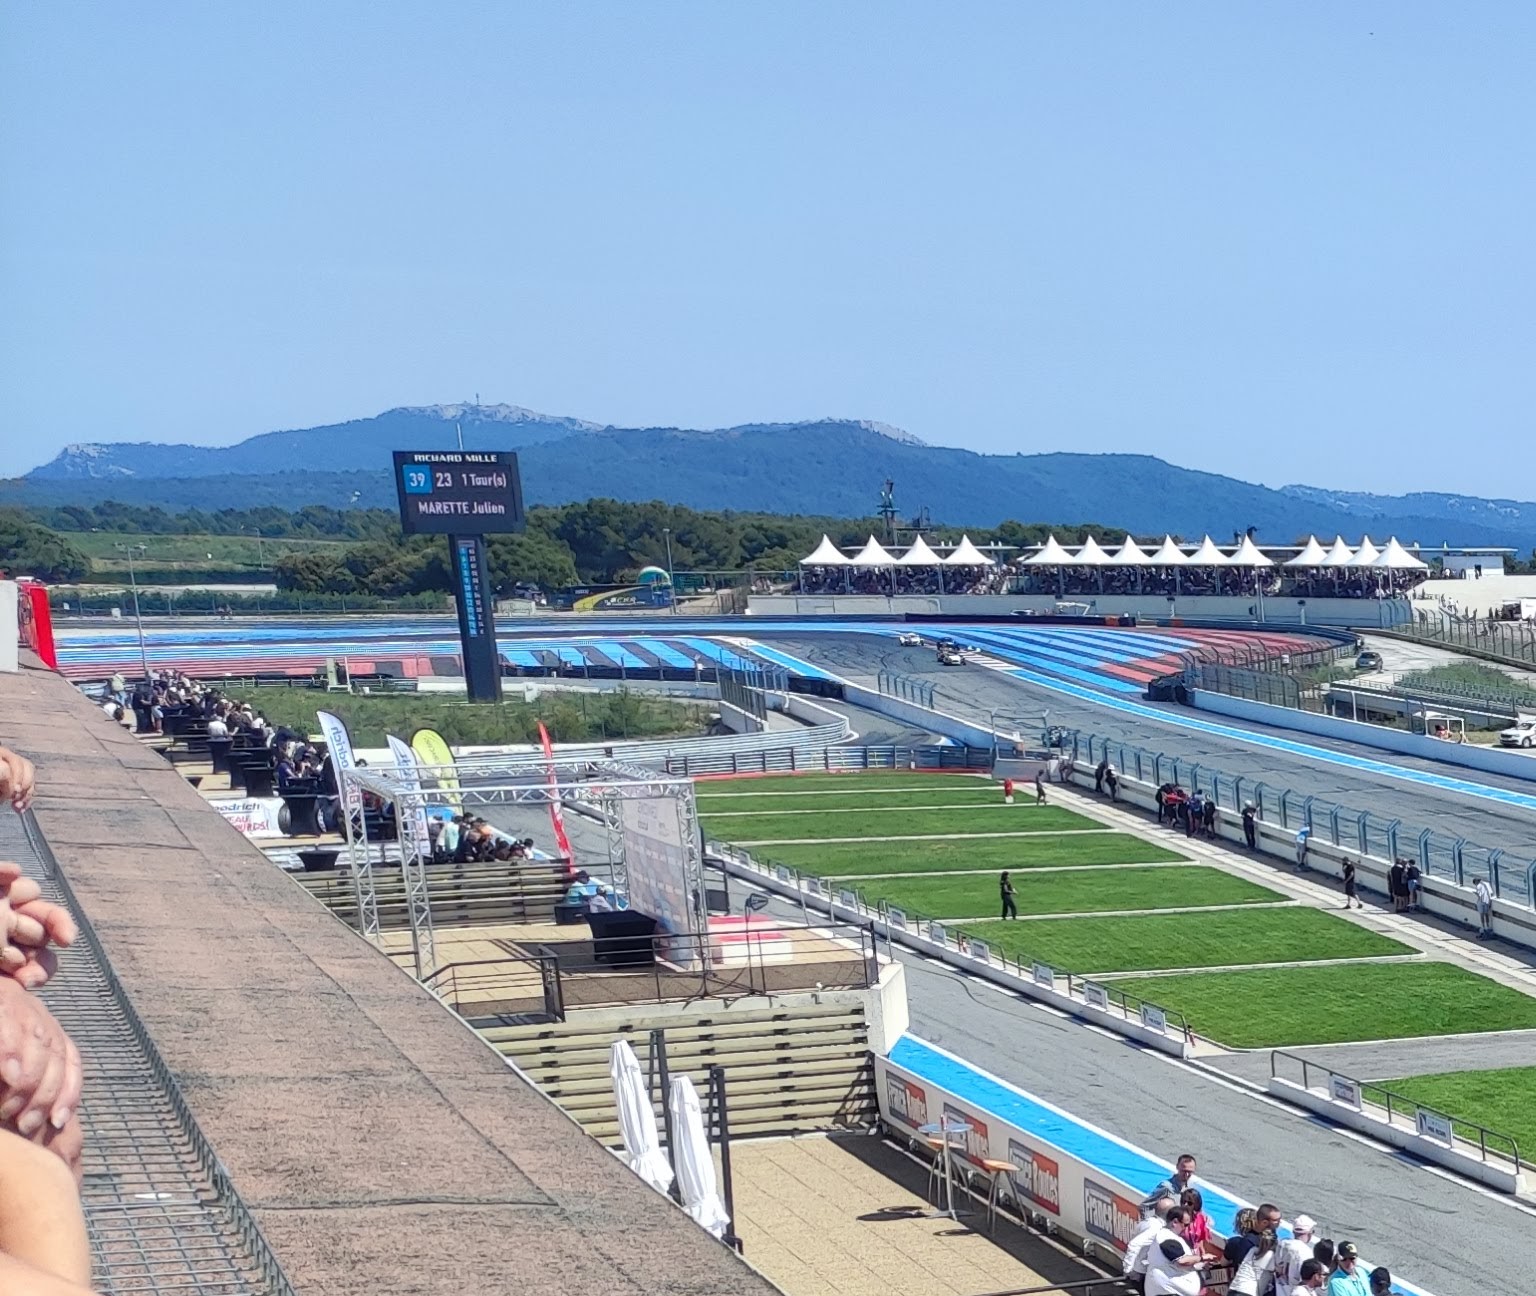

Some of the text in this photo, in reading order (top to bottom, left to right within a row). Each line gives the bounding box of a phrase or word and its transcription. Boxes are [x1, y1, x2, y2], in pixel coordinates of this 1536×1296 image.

[414, 454, 498, 463] RICHARD MILLE
[409, 472, 425, 487] 39
[435, 472, 452, 488] 23
[470, 472, 507, 488] Tour(s)
[418, 501, 505, 515] MARETTE Julien
